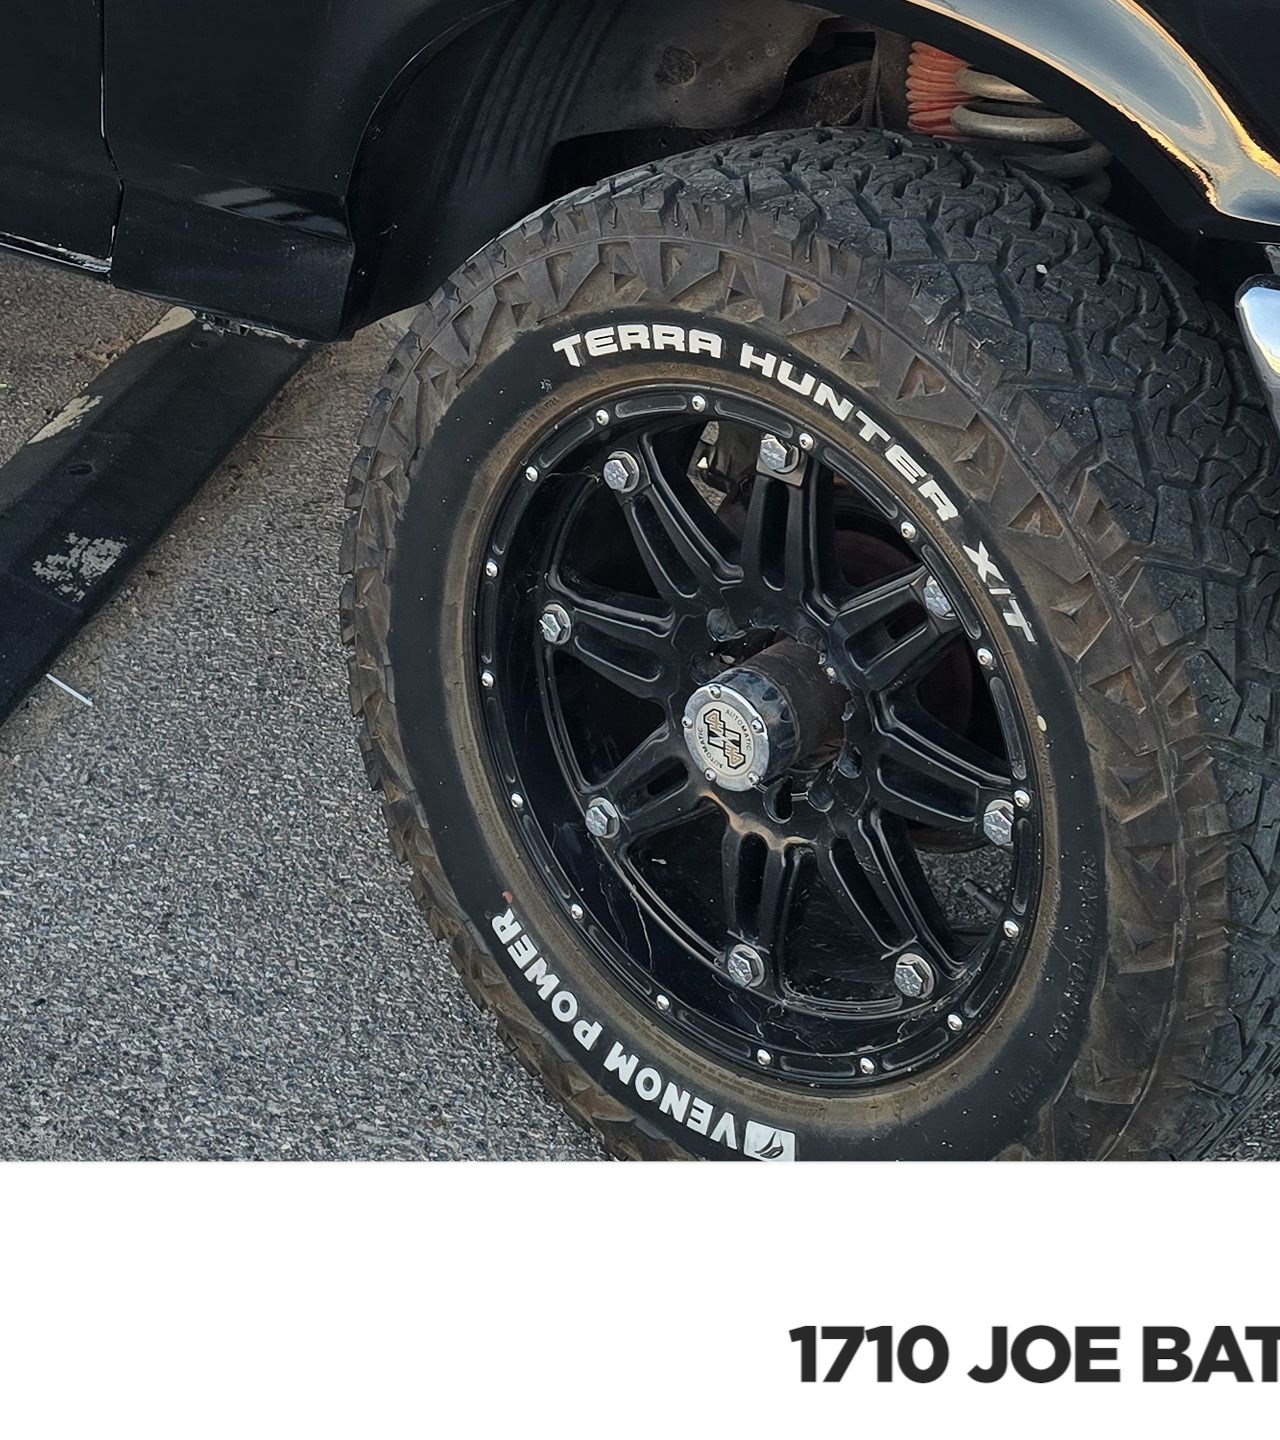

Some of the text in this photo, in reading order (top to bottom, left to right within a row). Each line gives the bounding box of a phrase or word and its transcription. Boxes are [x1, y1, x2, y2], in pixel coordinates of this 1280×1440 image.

[552, 323, 1038, 645] TERRA HUNTER X/T
[490, 907, 739, 1150] VENOM POWER
